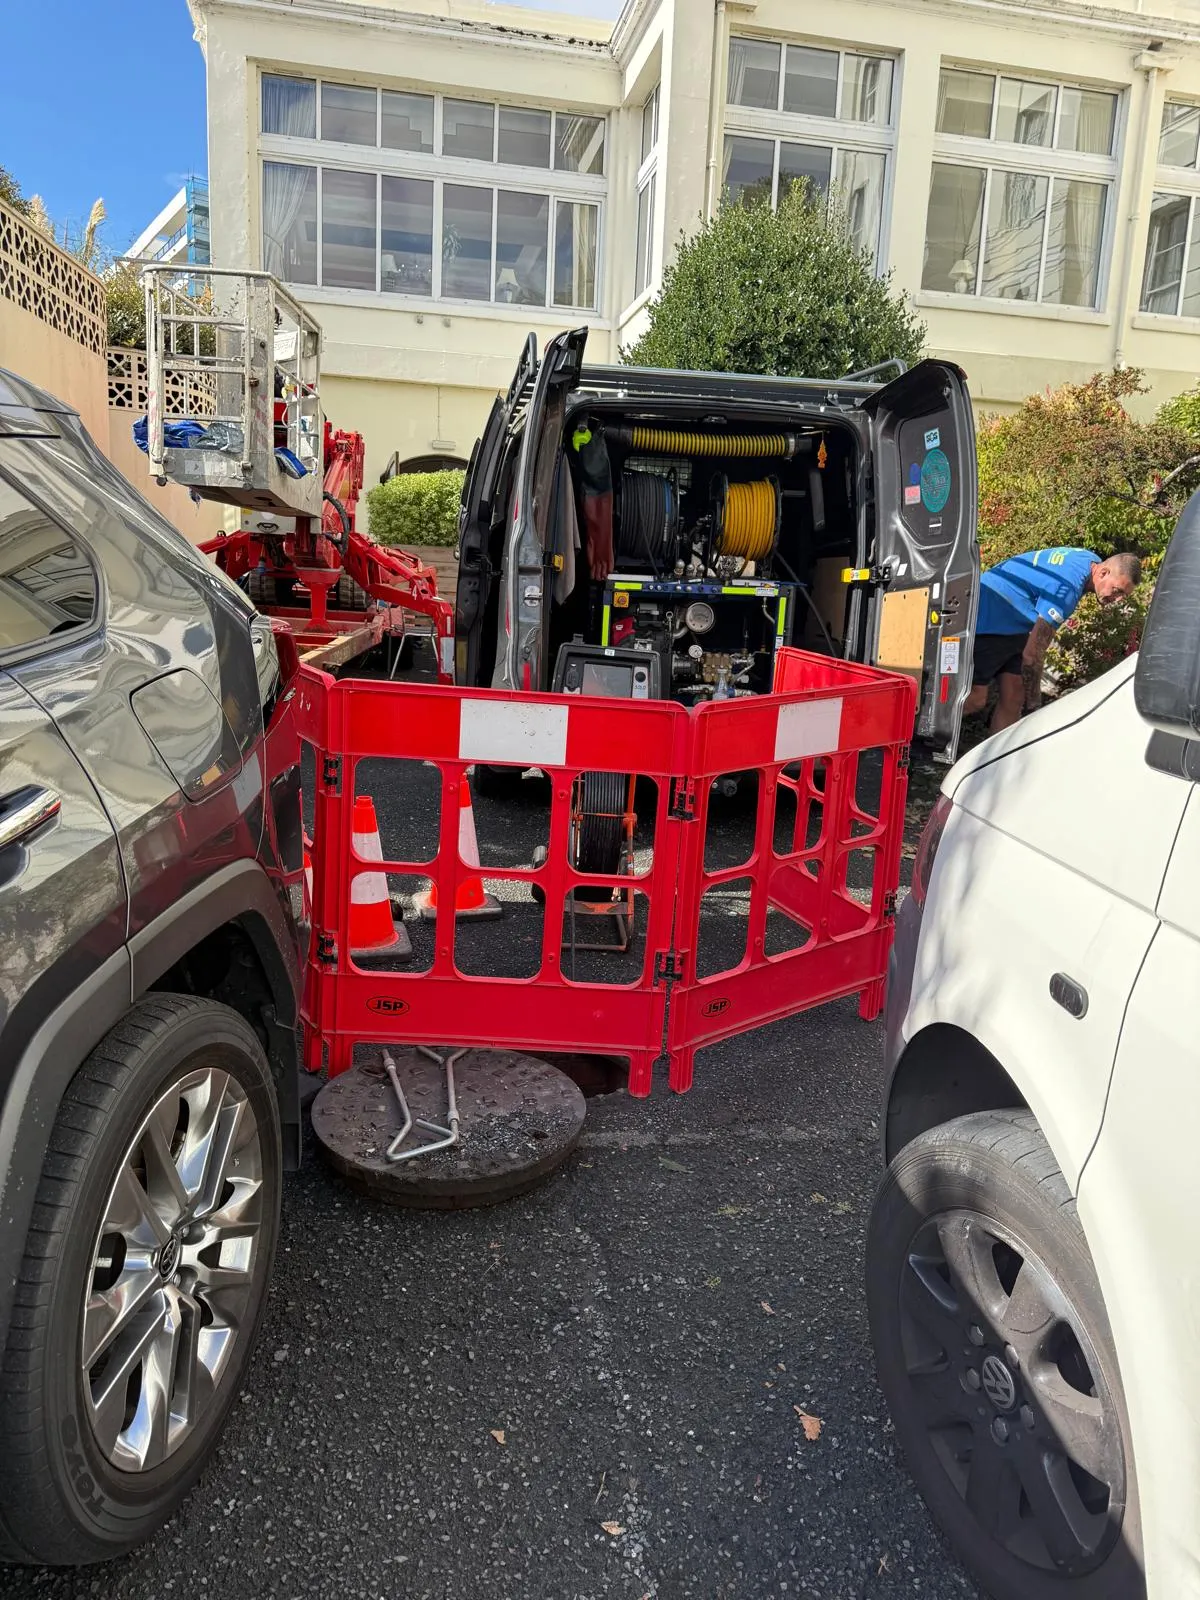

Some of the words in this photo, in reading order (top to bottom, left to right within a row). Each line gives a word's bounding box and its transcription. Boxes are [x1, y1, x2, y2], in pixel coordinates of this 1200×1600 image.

[372, 999, 404, 1011] JSP
[704, 1001, 728, 1014] JSP
[61, 1414, 106, 1518] TOYO
